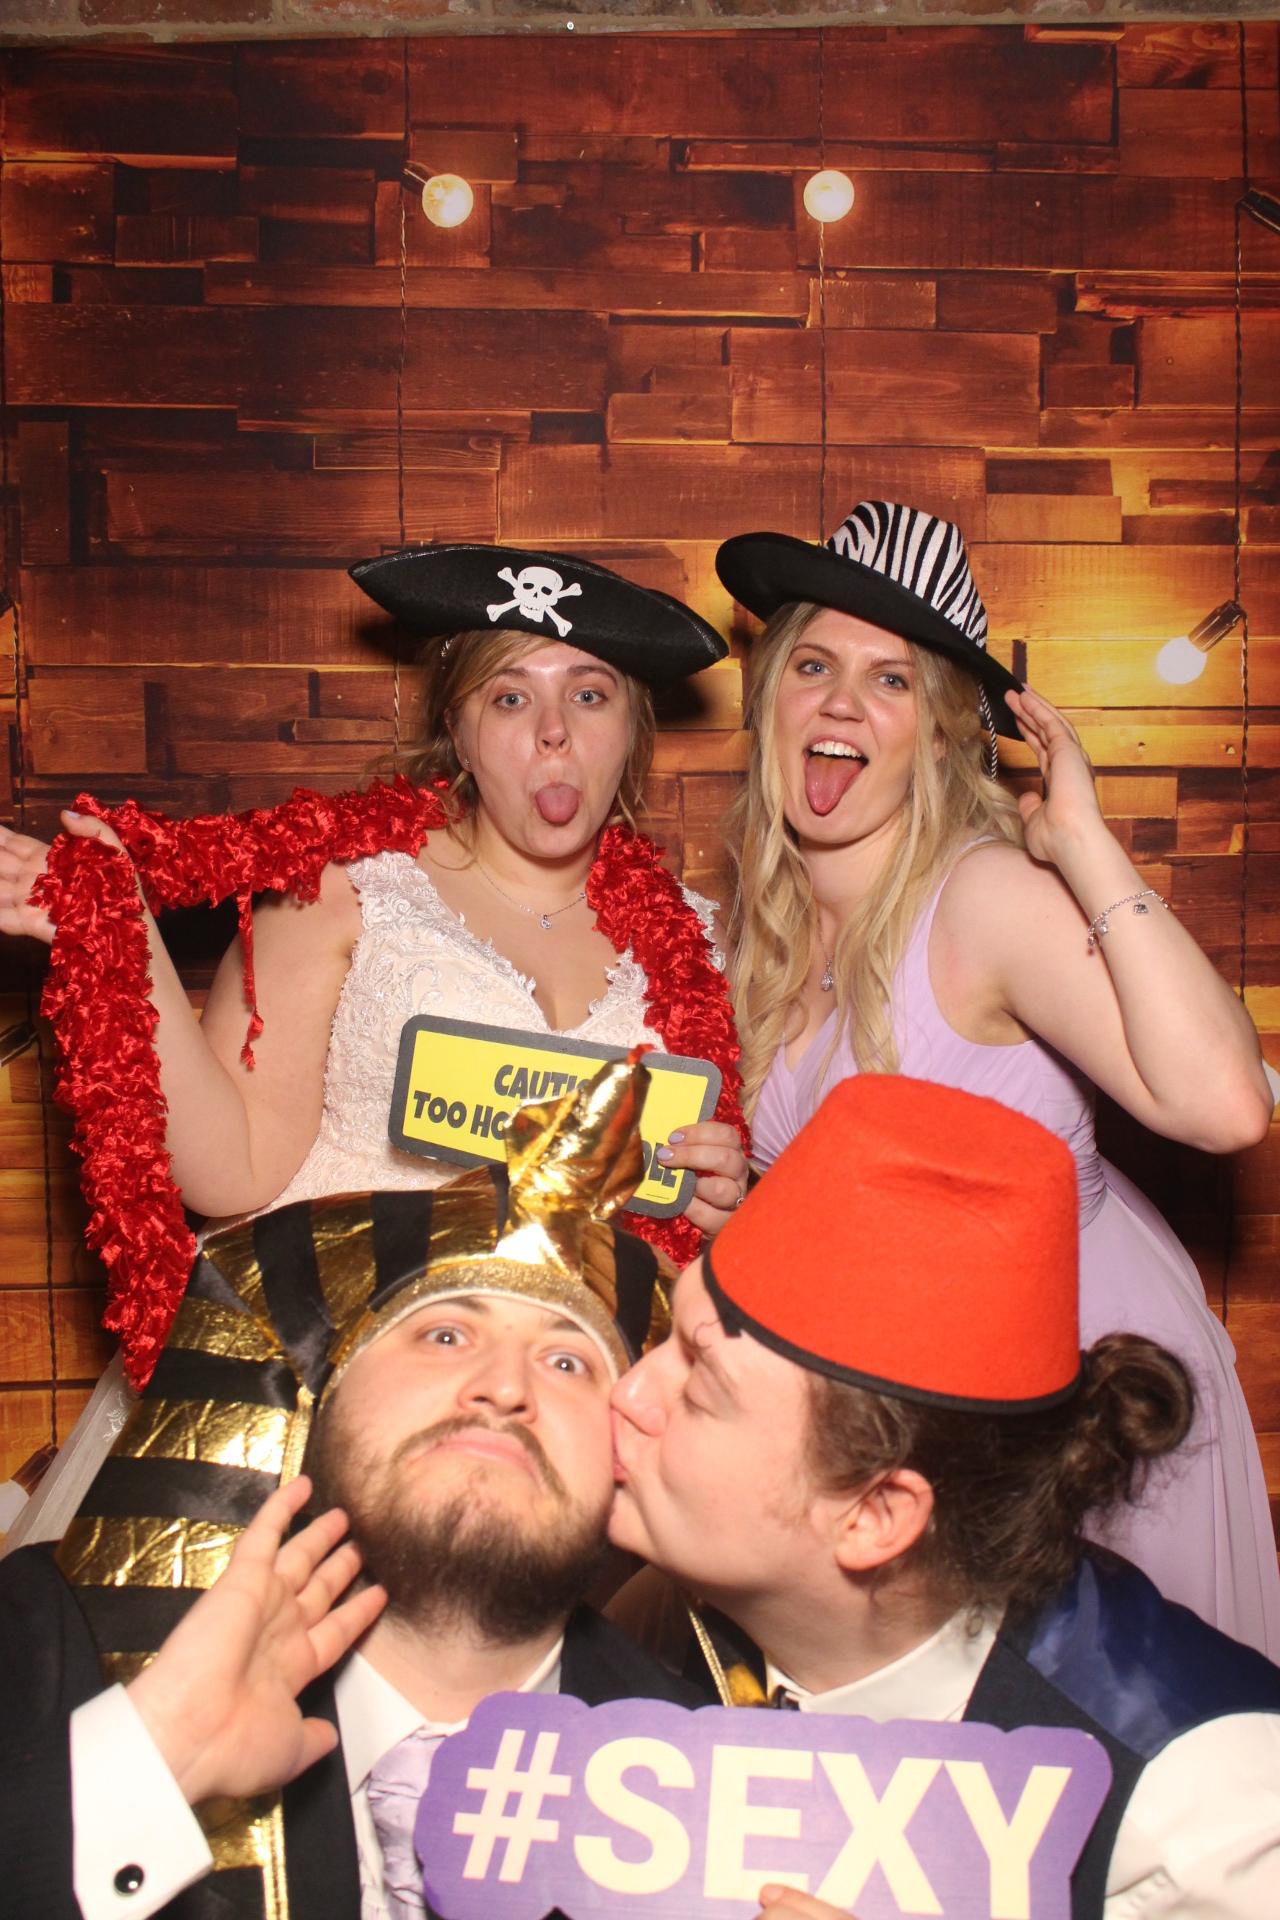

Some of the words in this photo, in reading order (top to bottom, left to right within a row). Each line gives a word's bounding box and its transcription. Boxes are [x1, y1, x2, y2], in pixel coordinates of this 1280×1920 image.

[494, 1064, 594, 1100] CAUTI
[413, 1090, 467, 1129] TOO
[470, 1104, 509, 1141] HO
[453, 1729, 1073, 1919] #SEXY
